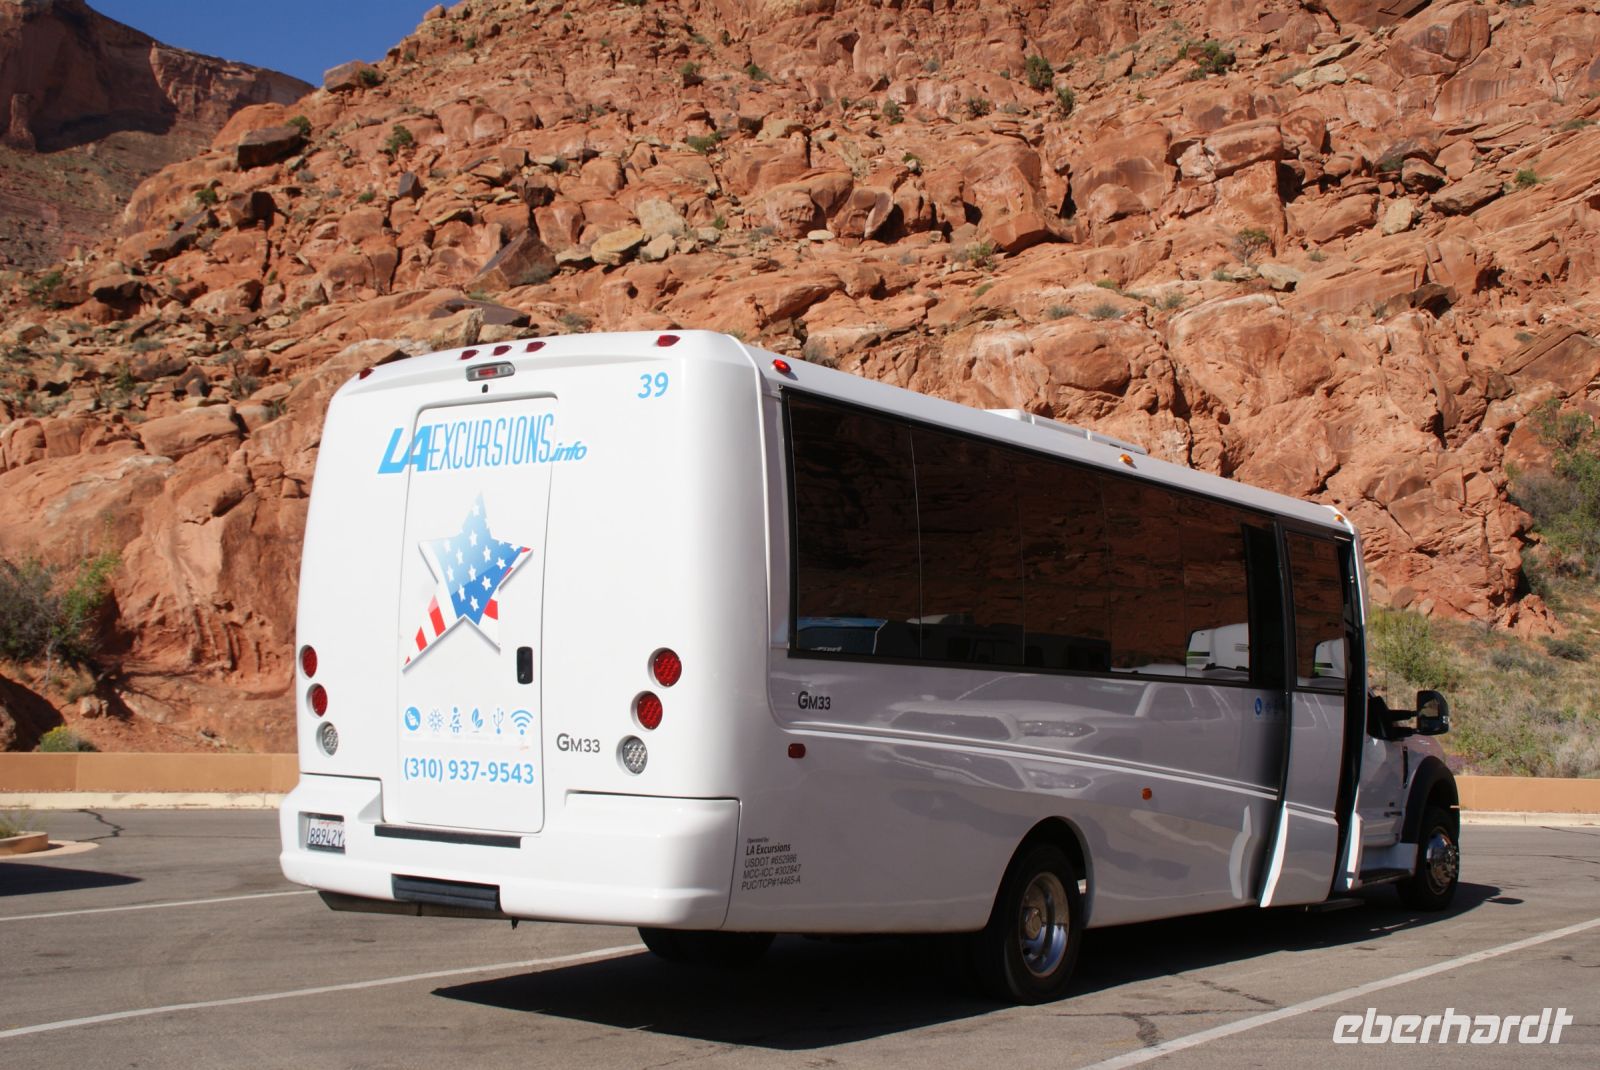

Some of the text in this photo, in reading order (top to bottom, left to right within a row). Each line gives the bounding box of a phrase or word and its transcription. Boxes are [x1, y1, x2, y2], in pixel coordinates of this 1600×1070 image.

[638, 372, 669, 399] 39
[798, 691, 831, 710] GM33
[556, 733, 601, 753] GM33
[404, 757, 534, 785] (310) 937-9543
[746, 843, 790, 855] LA Excursions
[744, 856, 769, 868] USDOT
